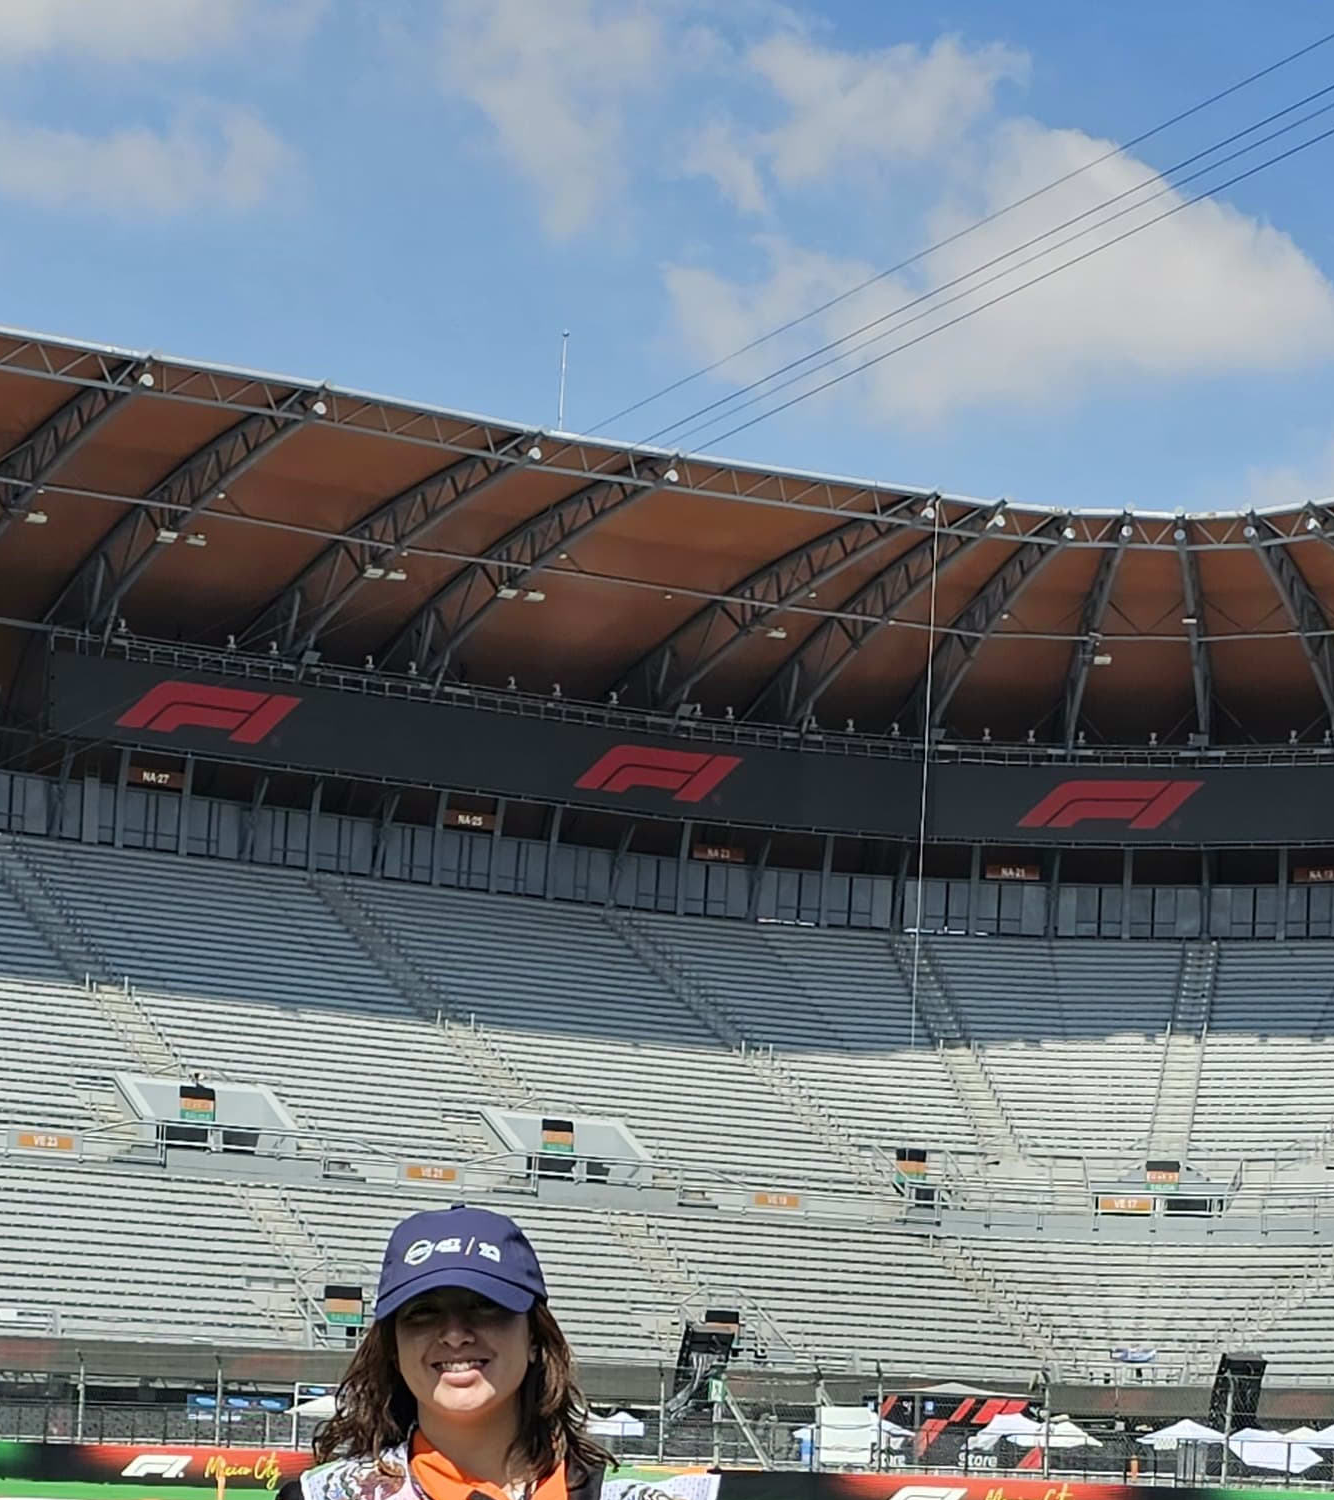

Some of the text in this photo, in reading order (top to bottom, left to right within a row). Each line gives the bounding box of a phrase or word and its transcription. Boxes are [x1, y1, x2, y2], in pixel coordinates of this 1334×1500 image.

[117, 681, 301, 744] F1
[574, 745, 742, 803] F1
[1018, 780, 1204, 830] F1
[1113, 1199, 1126, 1209] VE
[121, 1454, 193, 1479] F1
[253, 1451, 281, 1490] City
[958, 1451, 998, 1468] Store
